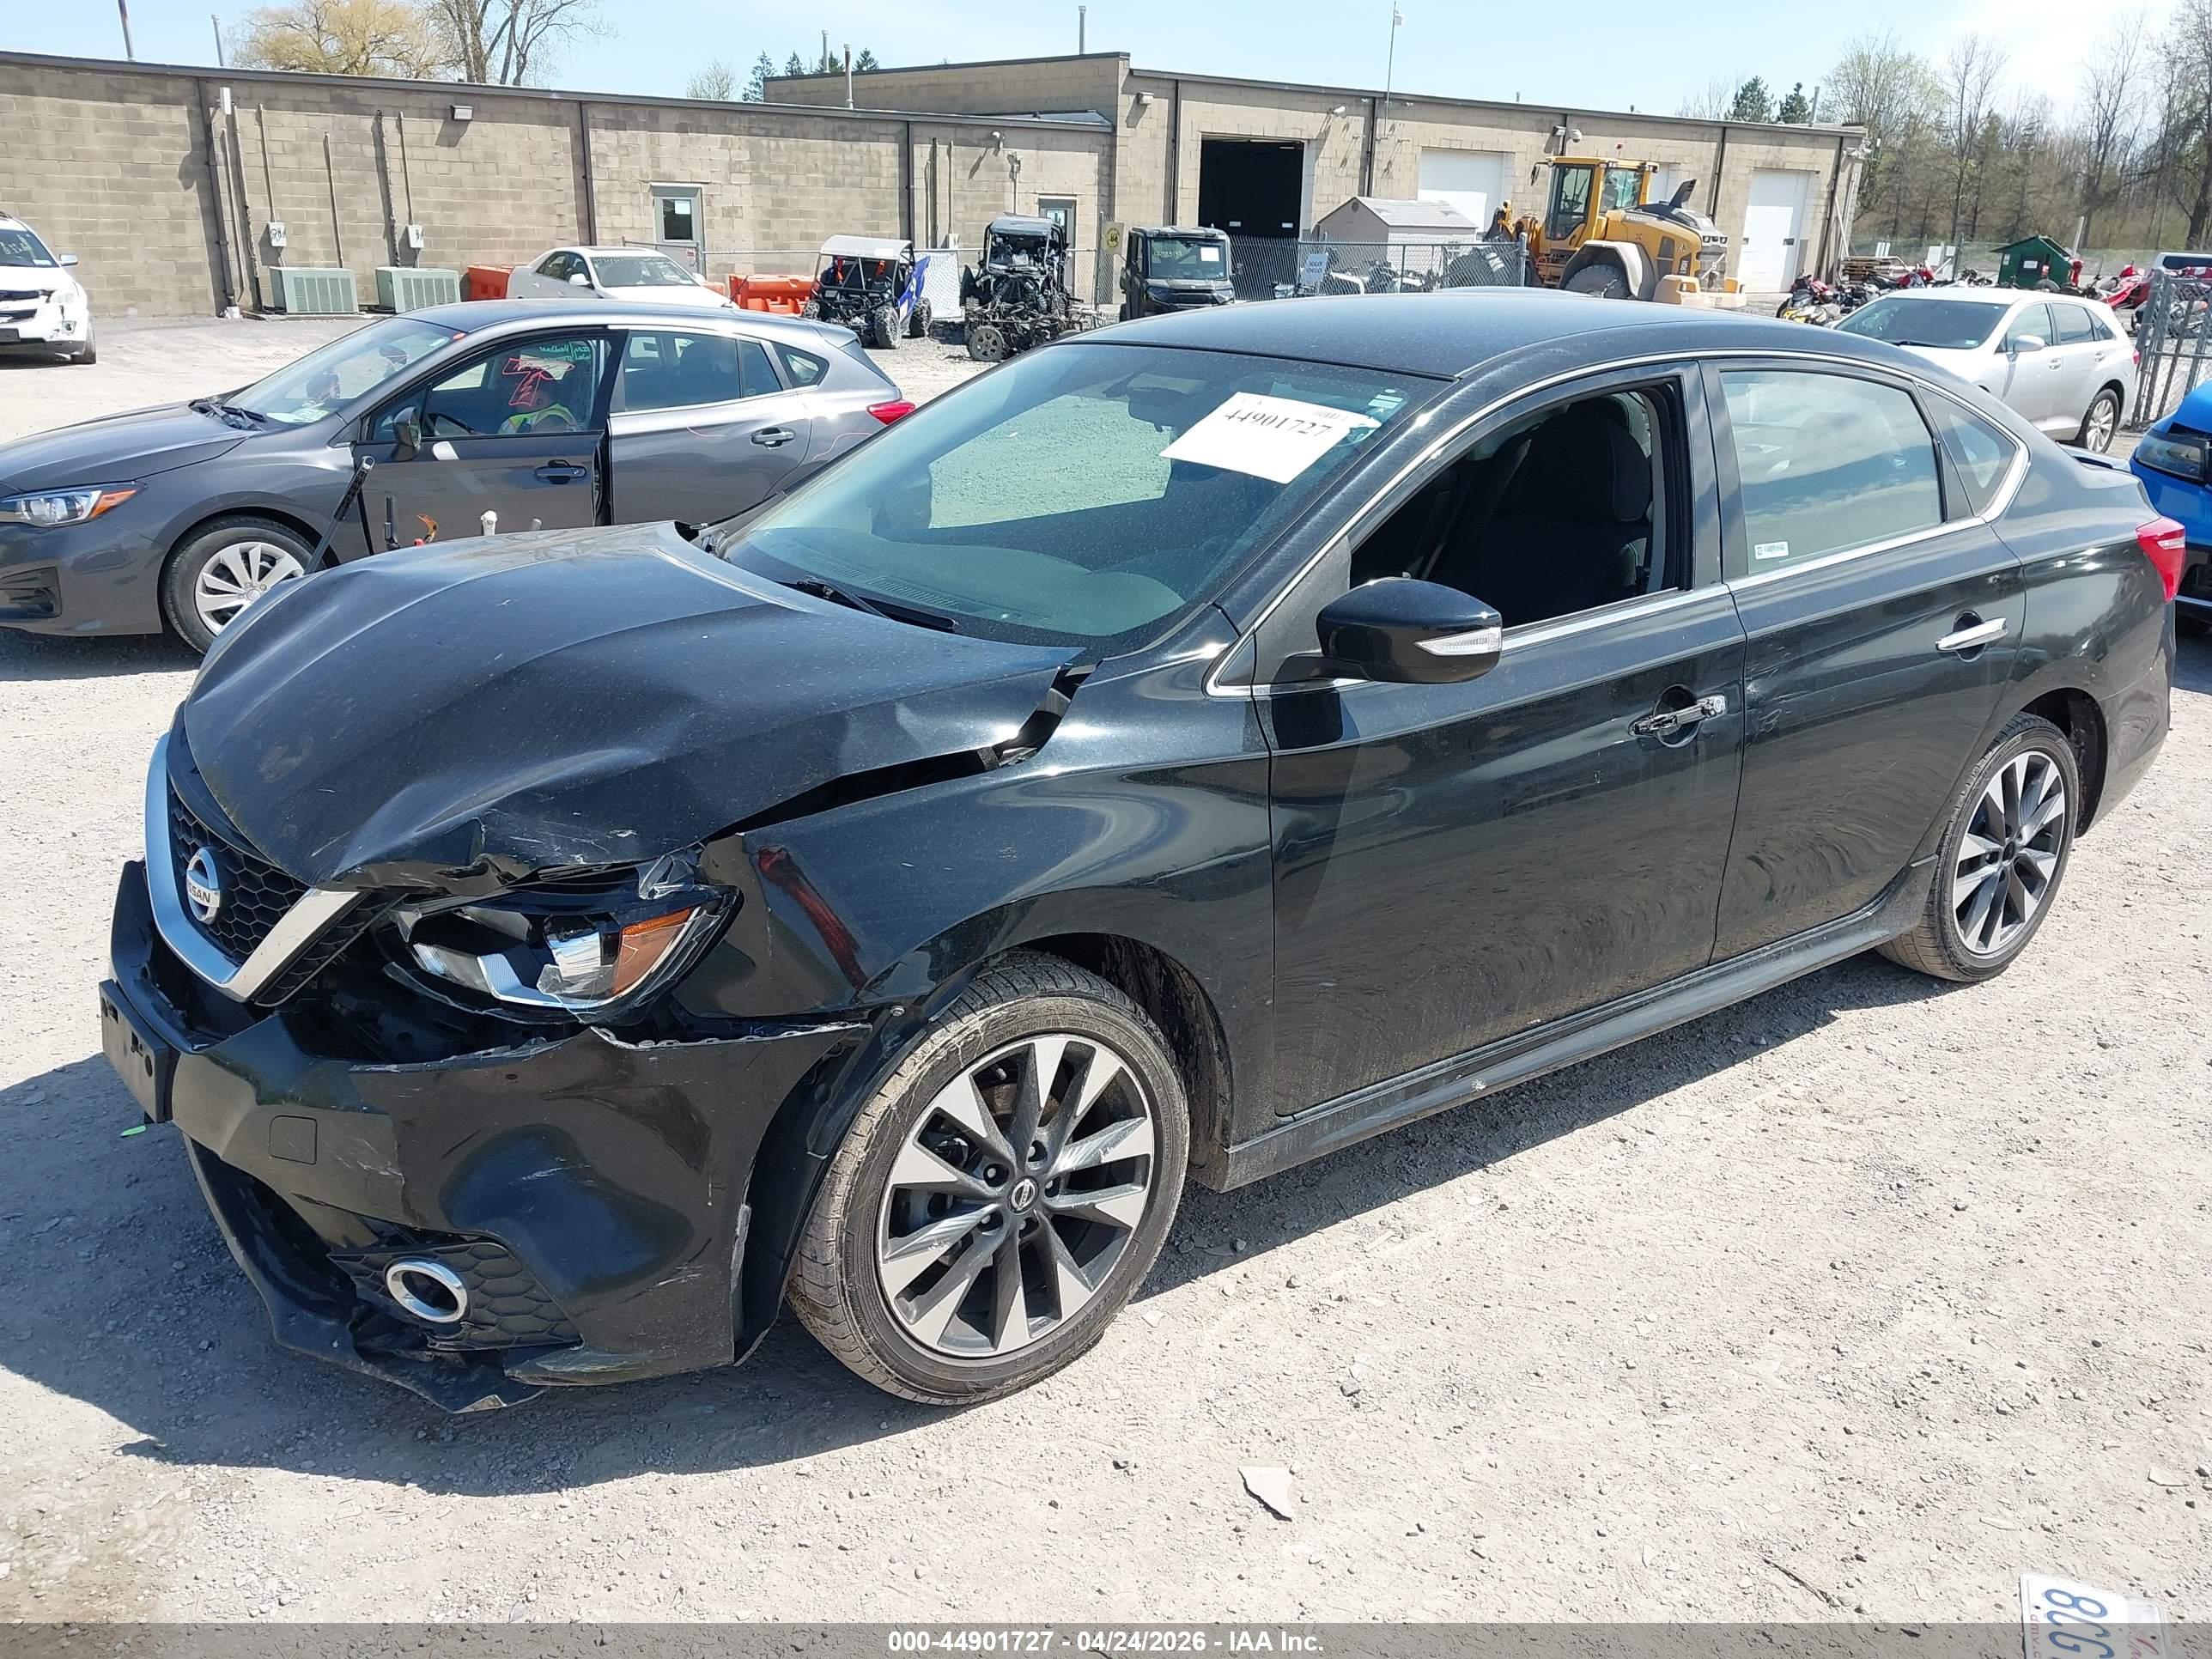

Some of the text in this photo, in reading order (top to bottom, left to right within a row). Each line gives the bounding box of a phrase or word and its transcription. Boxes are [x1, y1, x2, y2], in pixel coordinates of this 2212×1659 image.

[1224, 409, 1334, 437] 44901727
[187, 881, 210, 903] SSAN
[2044, 1589, 2115, 1659] 8CG
